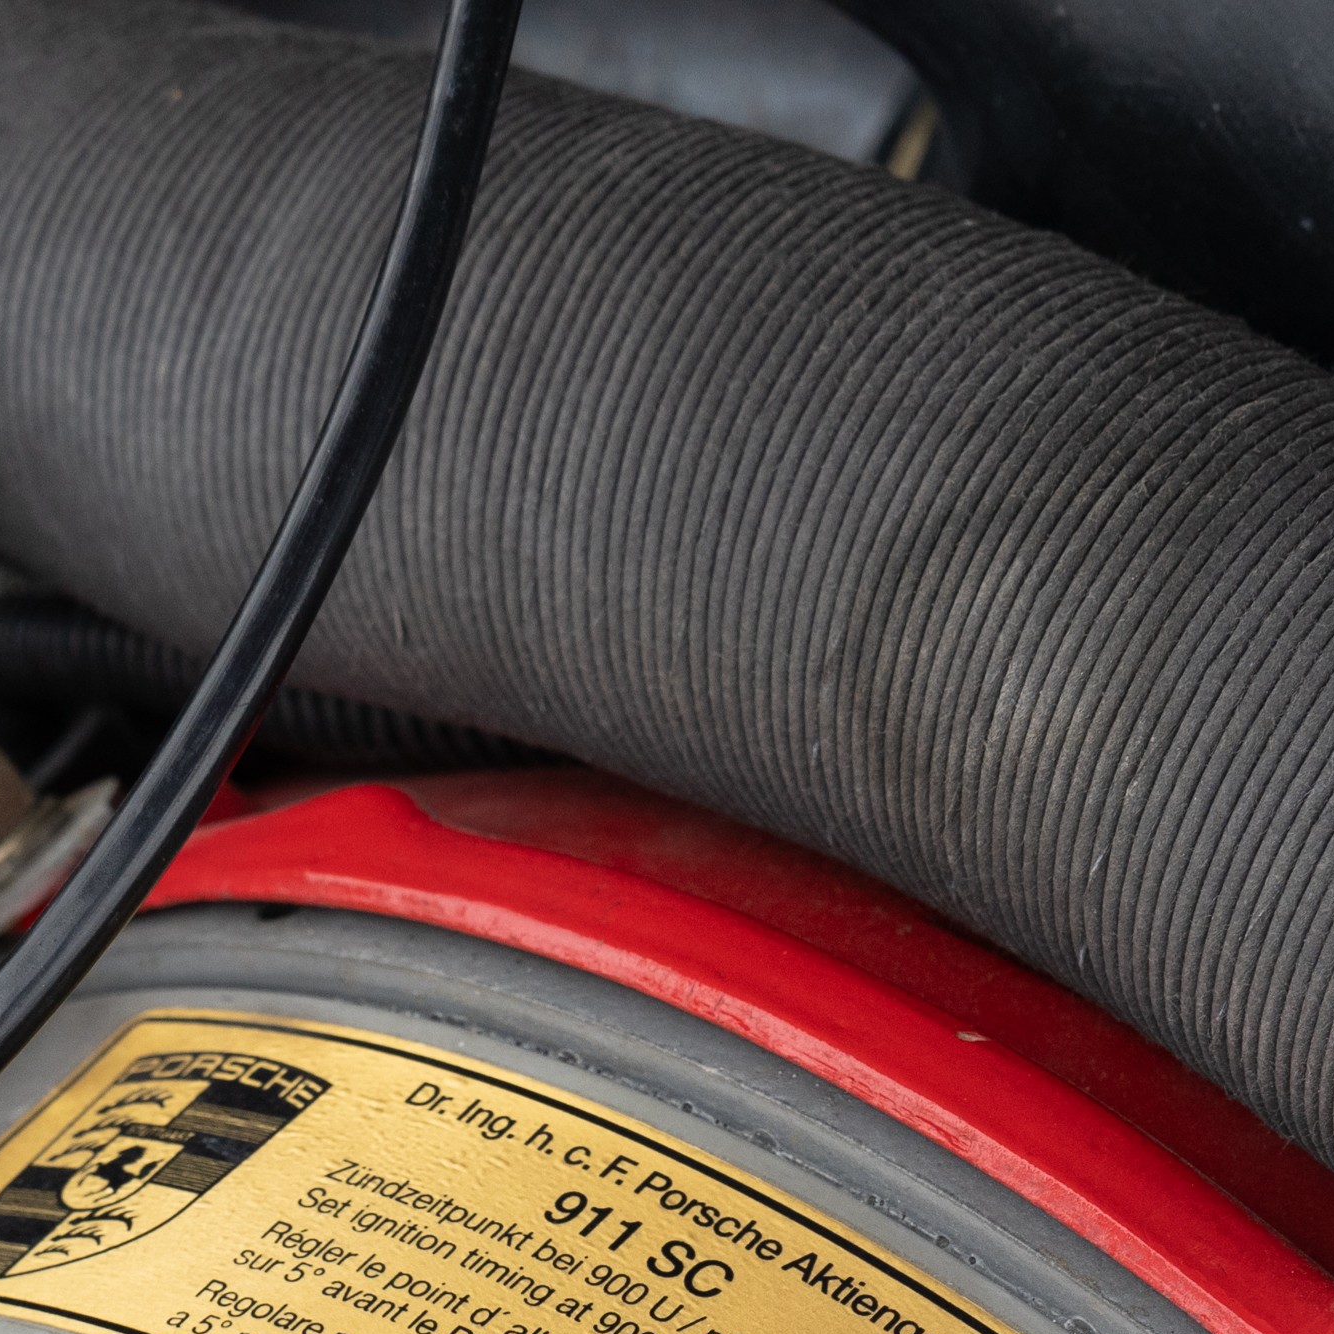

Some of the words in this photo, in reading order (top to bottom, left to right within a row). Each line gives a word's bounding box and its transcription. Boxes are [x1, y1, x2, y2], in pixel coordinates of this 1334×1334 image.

[122, 1053, 323, 1110] PORSCHE
[404, 1081, 454, 1115] Dr.
[456, 1098, 517, 1141] Ing.
[524, 1123, 554, 1155] h.
[563, 1145, 592, 1171] c.
[598, 1154, 640, 1186] F.
[633, 1170, 783, 1261] Porsche
[233, 1249, 285, 1273] sur
[321, 1280, 410, 1323] avant
[261, 1220, 359, 1266] Régler
[356, 1253, 386, 1279] le
[382, 1271, 471, 1315] point
[297, 1187, 353, 1215] Set
[349, 1209, 457, 1260] ignition
[459, 1248, 556, 1307] timing
[555, 1297, 594, 1323] at
[324, 1159, 534, 1252] Zündzeitpunkt
[531, 1238, 588, 1276] bei
[584, 1264, 650, 1306] 900
[648, 1295, 685, 1323] U
[675, 1315, 708, 1333] /
[543, 1190, 643, 1252] 911
[646, 1239, 735, 1299] SC
[166, 1311, 190, 1329] a
